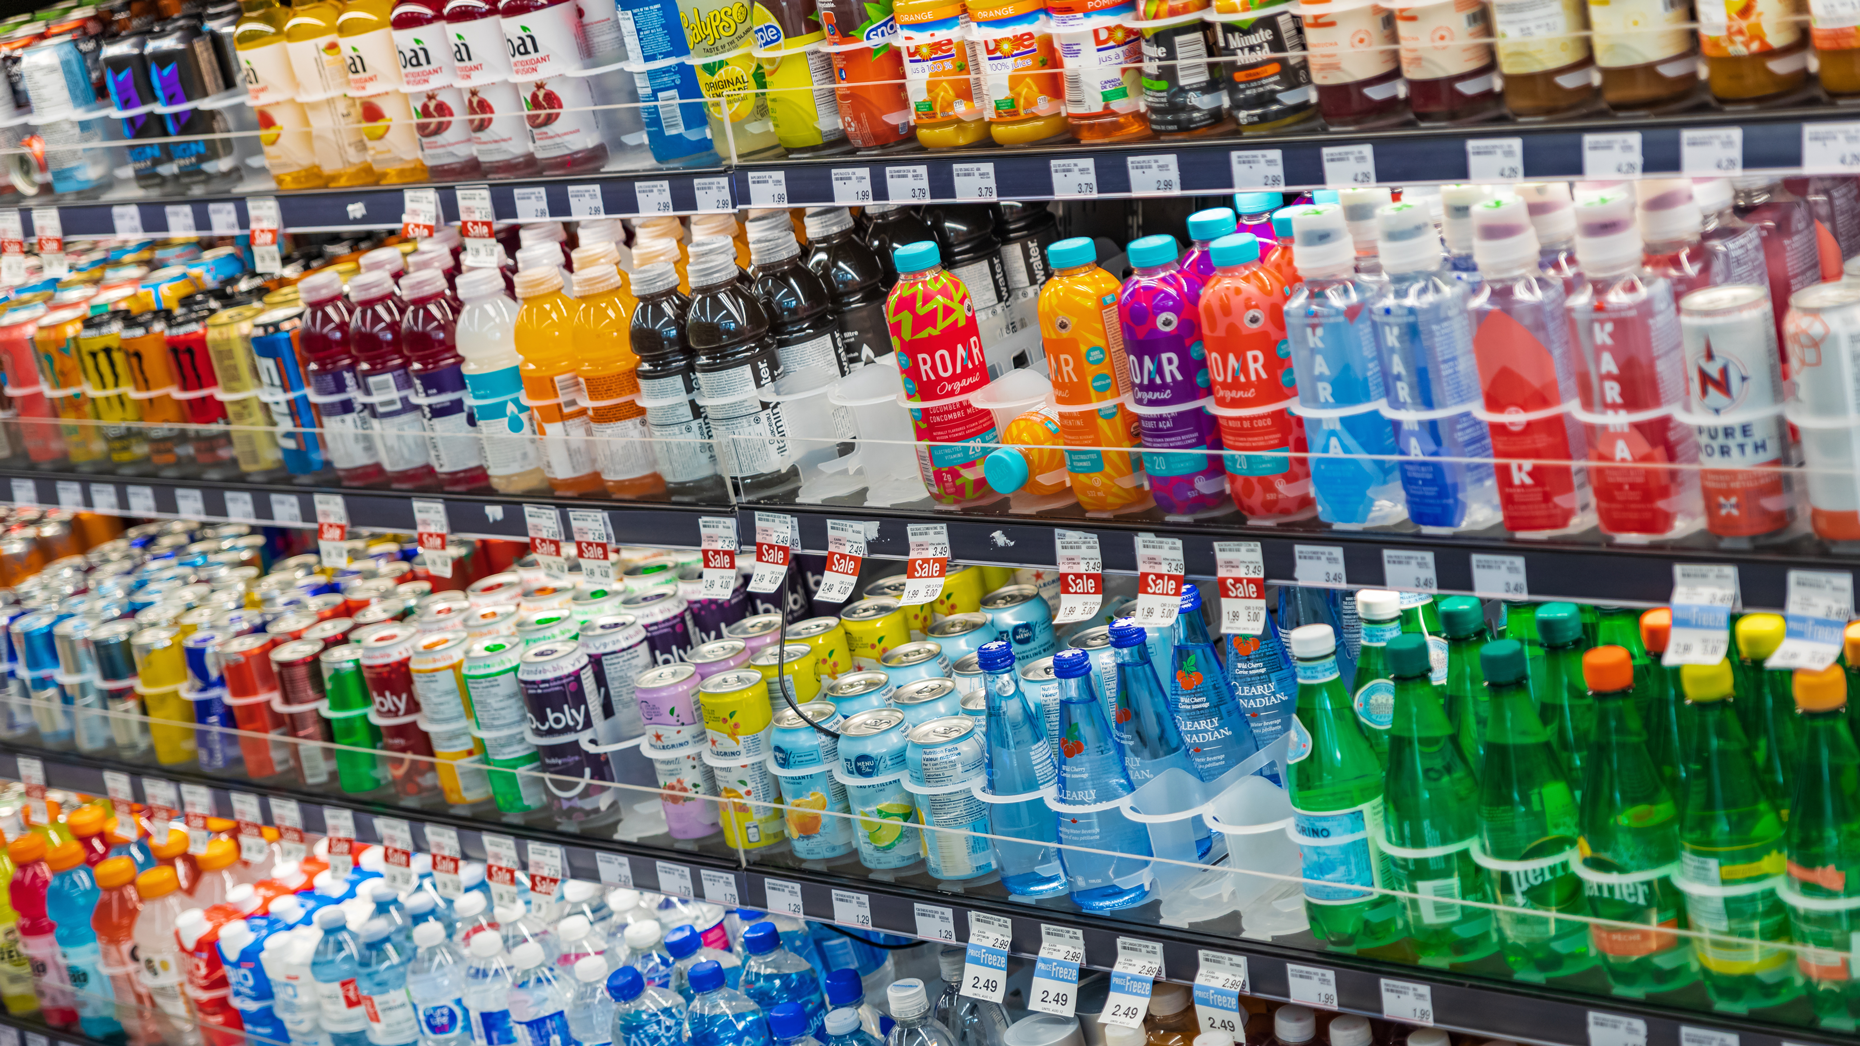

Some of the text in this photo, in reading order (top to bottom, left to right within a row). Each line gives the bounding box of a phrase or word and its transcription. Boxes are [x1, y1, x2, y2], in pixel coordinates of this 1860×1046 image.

[900, 11, 934, 22] ORANGE
[977, 6, 1015, 19] ORANGE
[1227, 28, 1274, 50] Minute
[989, 58, 1033, 72] 100% juice
[1098, 54, 1112, 65] jus
[911, 65, 920, 75] jus
[927, 61, 943, 73] 100
[705, 75, 749, 92] ORIGINAL
[1100, 77, 1121, 86] CANADA
[1108, 81, 1125, 90] CHOIX
[1156, 179, 1173, 191] 2.99
[1264, 174, 1281, 186] 2.99
[910, 186, 927, 199] 3.79
[977, 185, 994, 198] 3.79
[1077, 181, 1094, 194] 3.79
[771, 192, 786, 205] 1.99
[855, 189, 870, 201] 1.99
[588, 206, 601, 217] 2.99
[657, 200, 671, 213] 2.99
[716, 199, 730, 211] 2.99
[534, 207, 547, 219] 2.99
[407, 223, 429, 238] Sale
[467, 221, 490, 238] Sale
[917, 335, 984, 382] ROAR
[1130, 351, 1184, 385] OAR
[937, 371, 981, 395] Organic
[1134, 387, 1173, 404] Organic
[1215, 385, 1257, 403] Organic
[929, 410, 966, 423] CONCOMBRE
[1253, 417, 1272, 428] COCO
[1153, 456, 1166, 470] 20
[1235, 454, 1248, 469] 20
[322, 523, 343, 540] Sale
[422, 534, 443, 551] Sale
[720, 539, 735, 549] 2.49
[775, 535, 789, 545] 2.49
[535, 538, 556, 556] Sale
[582, 542, 604, 559] Sale
[849, 544, 863, 555] 2.49
[932, 546, 948, 557] 3.49
[708, 551, 731, 568] Sale
[762, 544, 784, 564] Sale
[832, 554, 855, 574] Sale
[915, 559, 940, 577] Sale
[1085, 562, 1101, 572] 3.49
[1167, 563, 1184, 574] 3.49
[1244, 565, 1262, 576] 3.49
[1068, 574, 1095, 593] Sale
[1324, 571, 1342, 584] 3.49
[1414, 576, 1434, 589] 3.49
[1147, 574, 1176, 595] Sale
[1226, 578, 1258, 598] Sale
[1504, 580, 1525, 594] 3.49
[906, 590, 919, 600] 1.99
[924, 588, 938, 598] 5.00
[1063, 606, 1076, 616] 1.99
[1081, 606, 1095, 616] 5.00
[1141, 607, 1155, 618] 1.99
[1160, 608, 1175, 619] 5.00
[1226, 610, 1240, 622] 1.99
[1246, 612, 1260, 623] 5.00
[1016, 631, 1033, 640] MENU
[1248, 662, 1264, 670] Cherry
[1249, 667, 1267, 675] sauvage
[1231, 681, 1276, 697] CLEARLY
[1191, 702, 1210, 710] sauvage
[1192, 696, 1207, 704] Cherry
[1239, 692, 1285, 709] NADIAN
[1184, 727, 1230, 744] NADIAN
[945, 746, 959, 754] Facts
[1206, 754, 1226, 762] Beverage
[1070, 771, 1089, 779] sauvage
[1071, 764, 1086, 773] Cherry
[1057, 783, 1097, 803] CLEARLY
[387, 850, 408, 866] Sale
[435, 856, 456, 871] Sale
[491, 865, 511, 884] Sale
[534, 876, 556, 895] Sale
[678, 884, 691, 896] 1.79
[723, 893, 737, 904] 1.79
[787, 902, 801, 914] 1.29
[855, 914, 870, 926] 1.29
[938, 928, 953, 940] 1.29
[992, 937, 1009, 950] 2.99
[968, 948, 1006, 968] PRICE Freeze
[1063, 950, 1082, 962] 2.99
[1037, 961, 1077, 981] PRICE Freeze
[1138, 964, 1158, 976] 2.99
[971, 975, 998, 993] 2.49
[1112, 976, 1151, 995] PRICE Freeze
[1222, 977, 1241, 991] 2.99
[1040, 990, 1069, 1007] 2.49
[1195, 989, 1237, 1010] PRICE Freeze
[1316, 992, 1335, 1006] 1.99
[1111, 1004, 1139, 1020] 2.49
[1411, 1007, 1431, 1021] 1.99
[1207, 1016, 1236, 1033] 2.49
